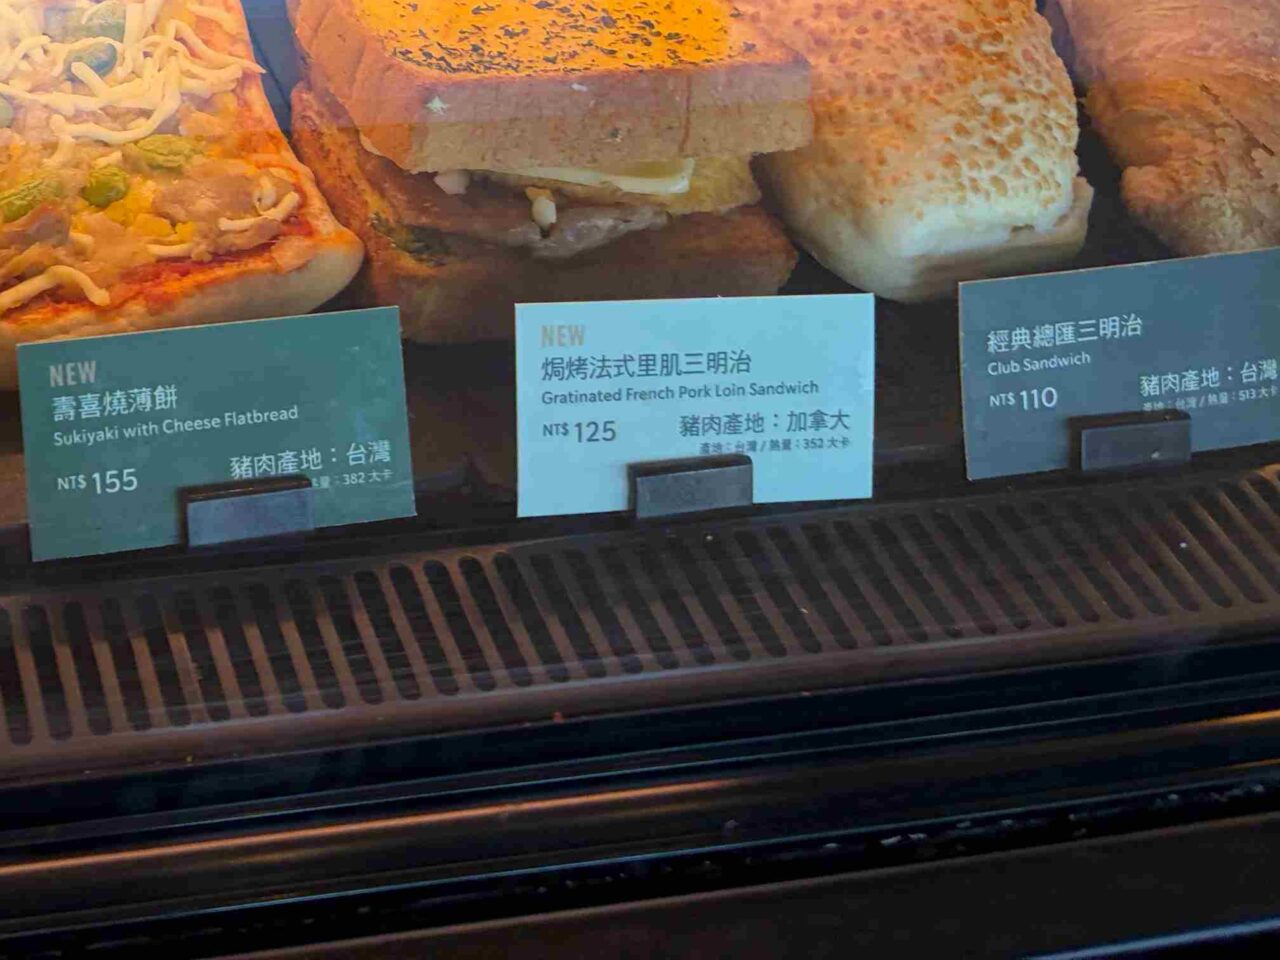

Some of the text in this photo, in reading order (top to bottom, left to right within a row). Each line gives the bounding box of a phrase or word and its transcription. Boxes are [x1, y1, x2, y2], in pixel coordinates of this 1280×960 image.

[540, 324, 586, 348] NEW
[987, 313, 1143, 354] 經典總匯三明治
[49, 360, 97, 387] NEW
[541, 348, 752, 382] 焗烤法式里肌三明治
[987, 351, 1091, 376] Club Sandwich
[1140, 359, 1278, 397] 豬肉產地：台灣
[52, 384, 177, 422] 壽喜燒薄餅
[541, 380, 819, 405] Gratinated French Pork Loin Sandwich
[989, 387, 1058, 411] NT$ 110
[53, 405, 300, 447] Sukiyaki with Cheese Flatbread
[542, 420, 617, 443] NT$ 125
[680, 408, 851, 438] 豬肉產地：加拿大
[229, 440, 392, 480] 豬肉產地：台灣
[57, 468, 138, 495] NT$ 155
